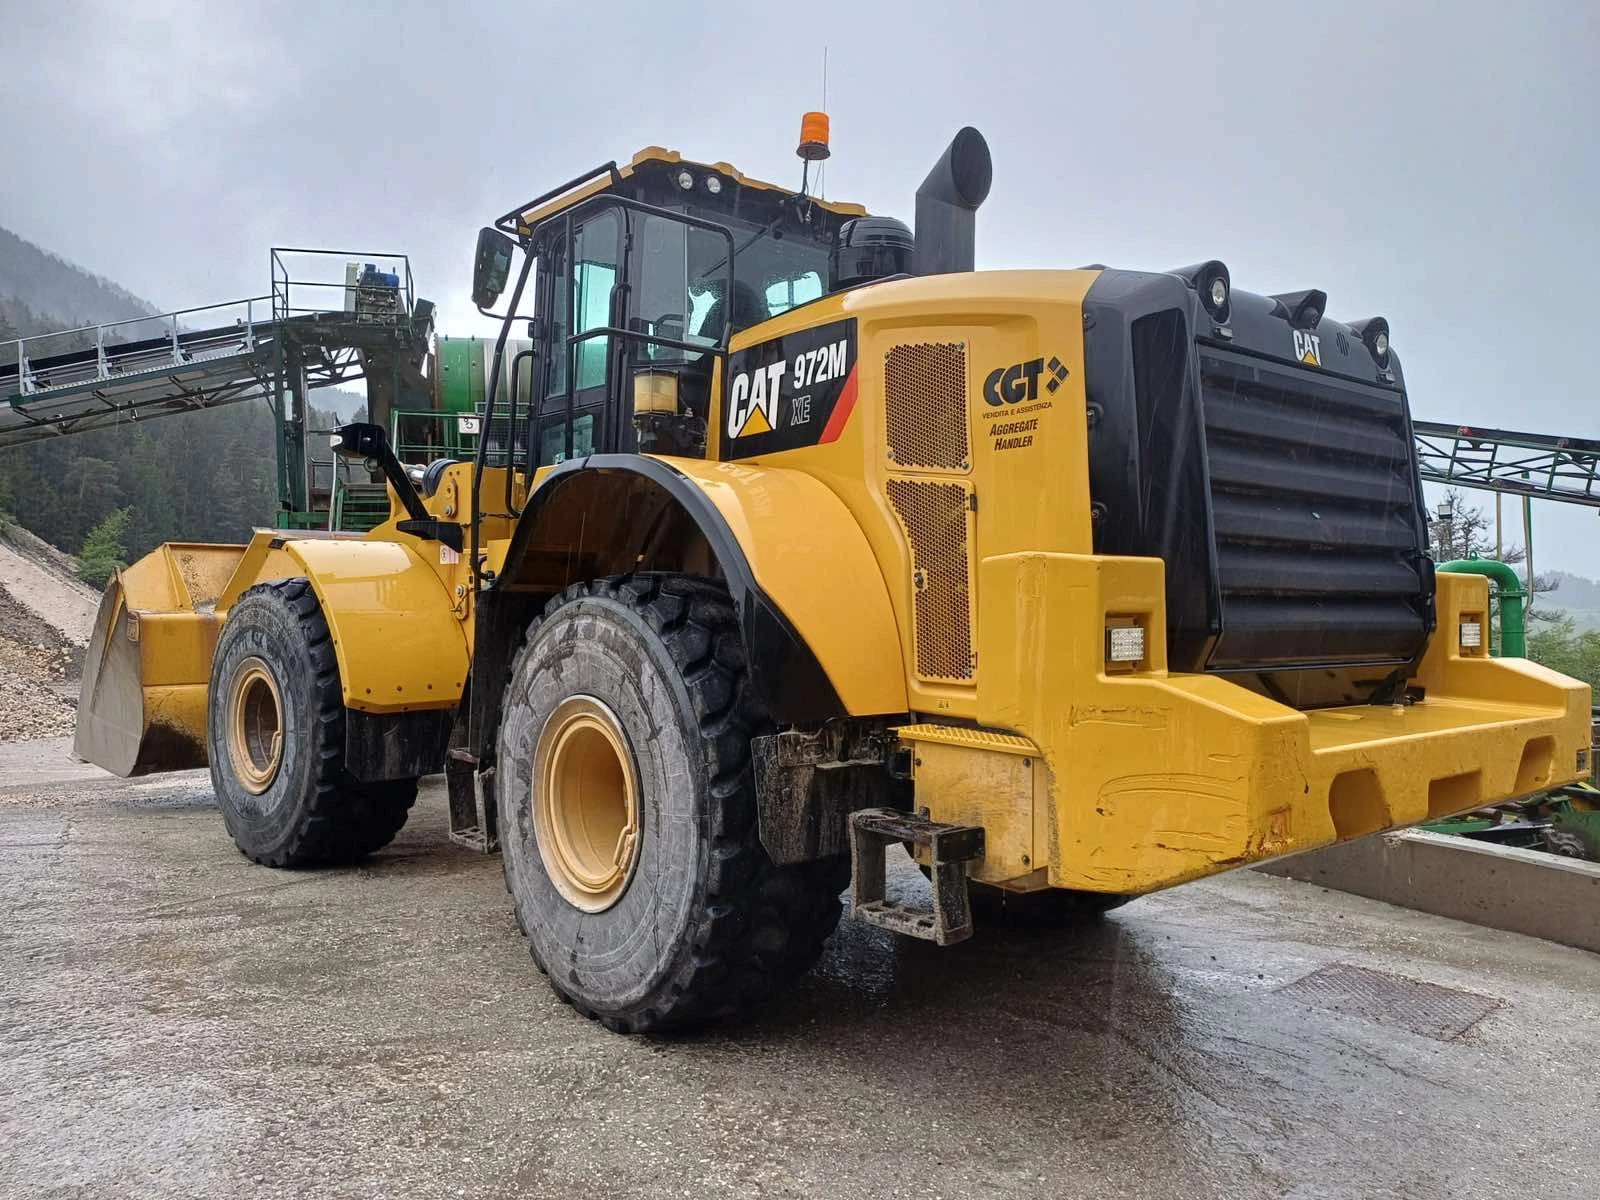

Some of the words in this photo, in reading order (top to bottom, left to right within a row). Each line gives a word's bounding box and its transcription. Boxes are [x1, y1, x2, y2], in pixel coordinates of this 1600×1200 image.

[793, 339, 848, 389] 972M
[1293, 330, 1321, 367] CAT
[728, 360, 787, 439] CAT
[983, 357, 1045, 407] CGT
[790, 394, 812, 427] XE
[983, 410, 1010, 420] VENDITA
[1016, 401, 1053, 414] ASSISTENZA
[989, 418, 1039, 437] AGGREGATE
[994, 435, 1033, 451] HANDLER
